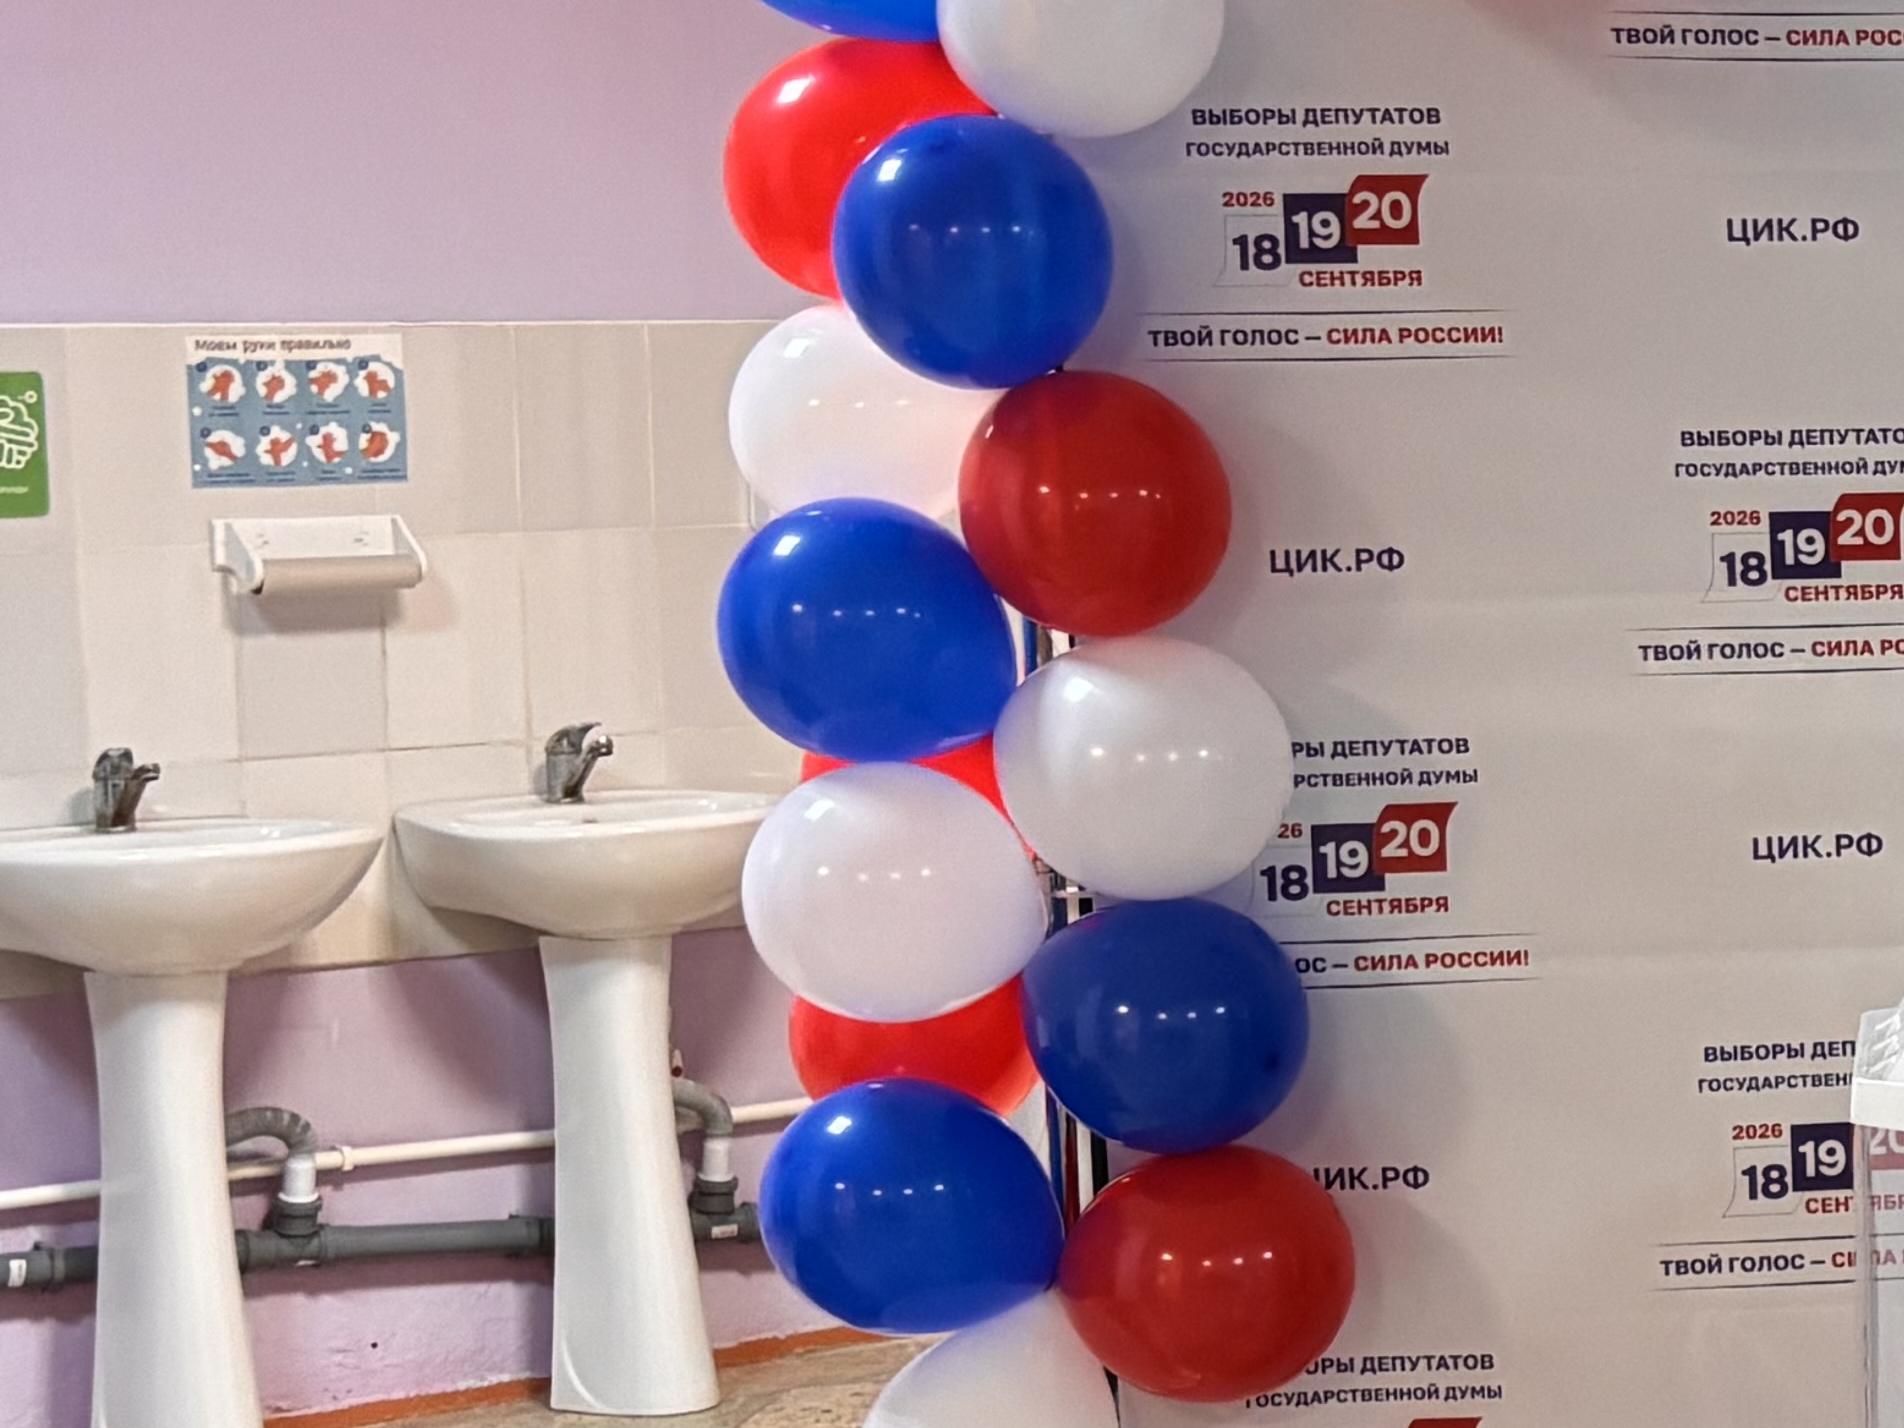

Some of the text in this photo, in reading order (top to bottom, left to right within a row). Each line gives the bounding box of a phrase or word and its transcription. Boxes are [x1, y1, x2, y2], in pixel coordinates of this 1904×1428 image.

[1192, 108, 1441, 127] ВЫБОРЫ ДЕПУТАТОВ
[1186, 139, 1449, 158] ГОСУДАРСТВЕННОЙ ДУМЫ
[1222, 192, 1275, 208] 2026
[1352, 191, 1412, 228] 20
[1291, 212, 1340, 250] 19
[1727, 217, 1859, 246] ЦИК.РФ
[1232, 234, 1282, 271] 18
[1298, 270, 1422, 288] СЕНТЯБРЯ
[1147, 326, 1213, 347] ТВОЙ
[1220, 330, 1299, 346] ГОЛОС
[1326, 328, 1392, 345] СИЛА
[1399, 326, 1504, 344] РОССИИ!
[1681, 430, 1782, 448] ВЫБОРЫ
[1675, 458, 1868, 479] ГОСУДАРСТВЕННОЙ
[1710, 510, 1762, 526] 2026
[1836, 508, 1895, 545] 20
[1777, 529, 1825, 566] 19
[1269, 547, 1404, 577] ЦИК.РФ
[1720, 551, 1769, 587] 18
[1784, 584, 1904, 602] СЕНТЯБРЯ
[1637, 640, 1701, 661] ТВОЙ
[1707, 643, 1784, 659] ГОЛОС
[1810, 640, 1874, 657] СИЛА
[1753, 832, 1883, 863] ЦИК.РФ
